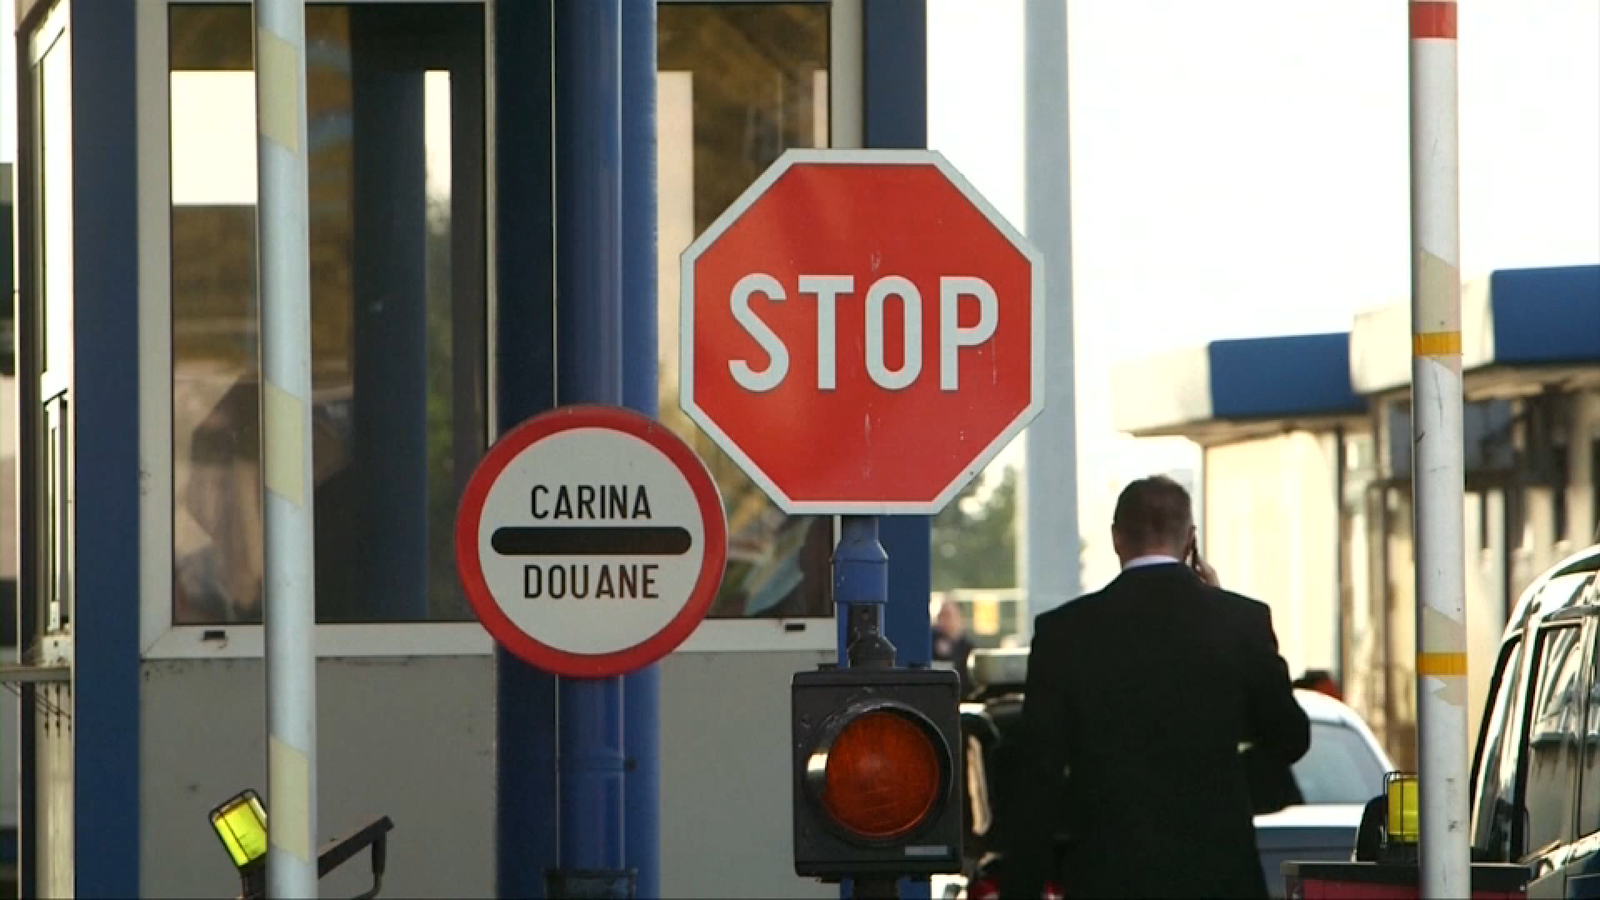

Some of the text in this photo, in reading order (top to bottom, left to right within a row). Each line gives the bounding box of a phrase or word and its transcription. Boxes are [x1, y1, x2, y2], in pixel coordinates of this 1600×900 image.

[728, 272, 999, 391] STOP
[530, 484, 653, 520] CARINA
[523, 564, 660, 600] DOUANE
